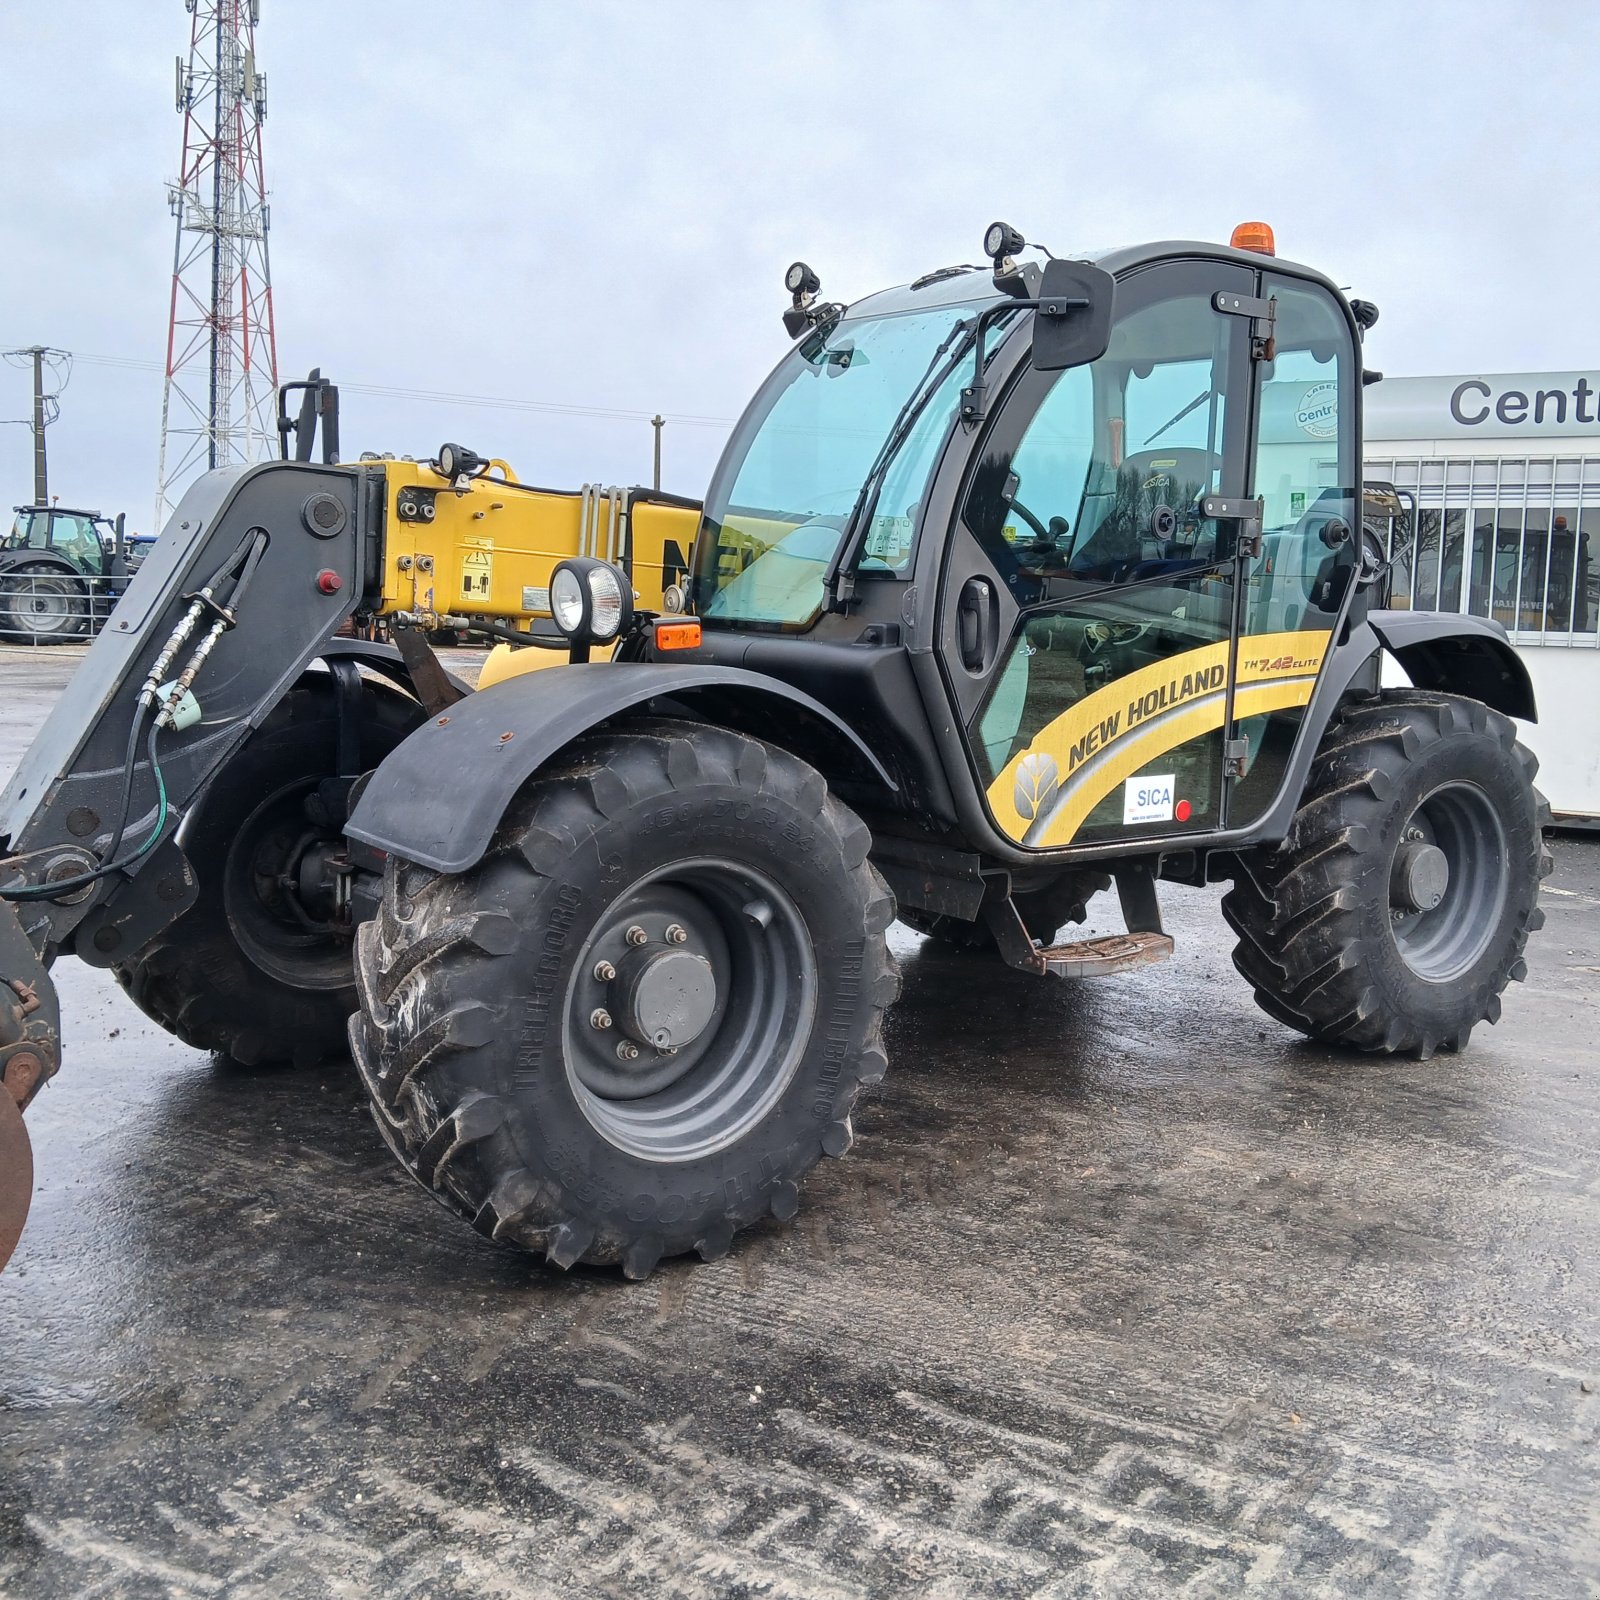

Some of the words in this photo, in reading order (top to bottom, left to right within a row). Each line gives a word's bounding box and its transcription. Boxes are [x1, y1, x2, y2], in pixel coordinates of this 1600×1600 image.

[1298, 404, 1337, 423] Centr
[1450, 378, 1600, 425] Cent
[1150, 478, 1170, 487] SICA
[1068, 710, 1121, 770] NEW
[1127, 664, 1225, 727] HOLLAND
[1137, 788, 1171, 807] SICA
[508, 882, 583, 1097] TRELLEBORG
